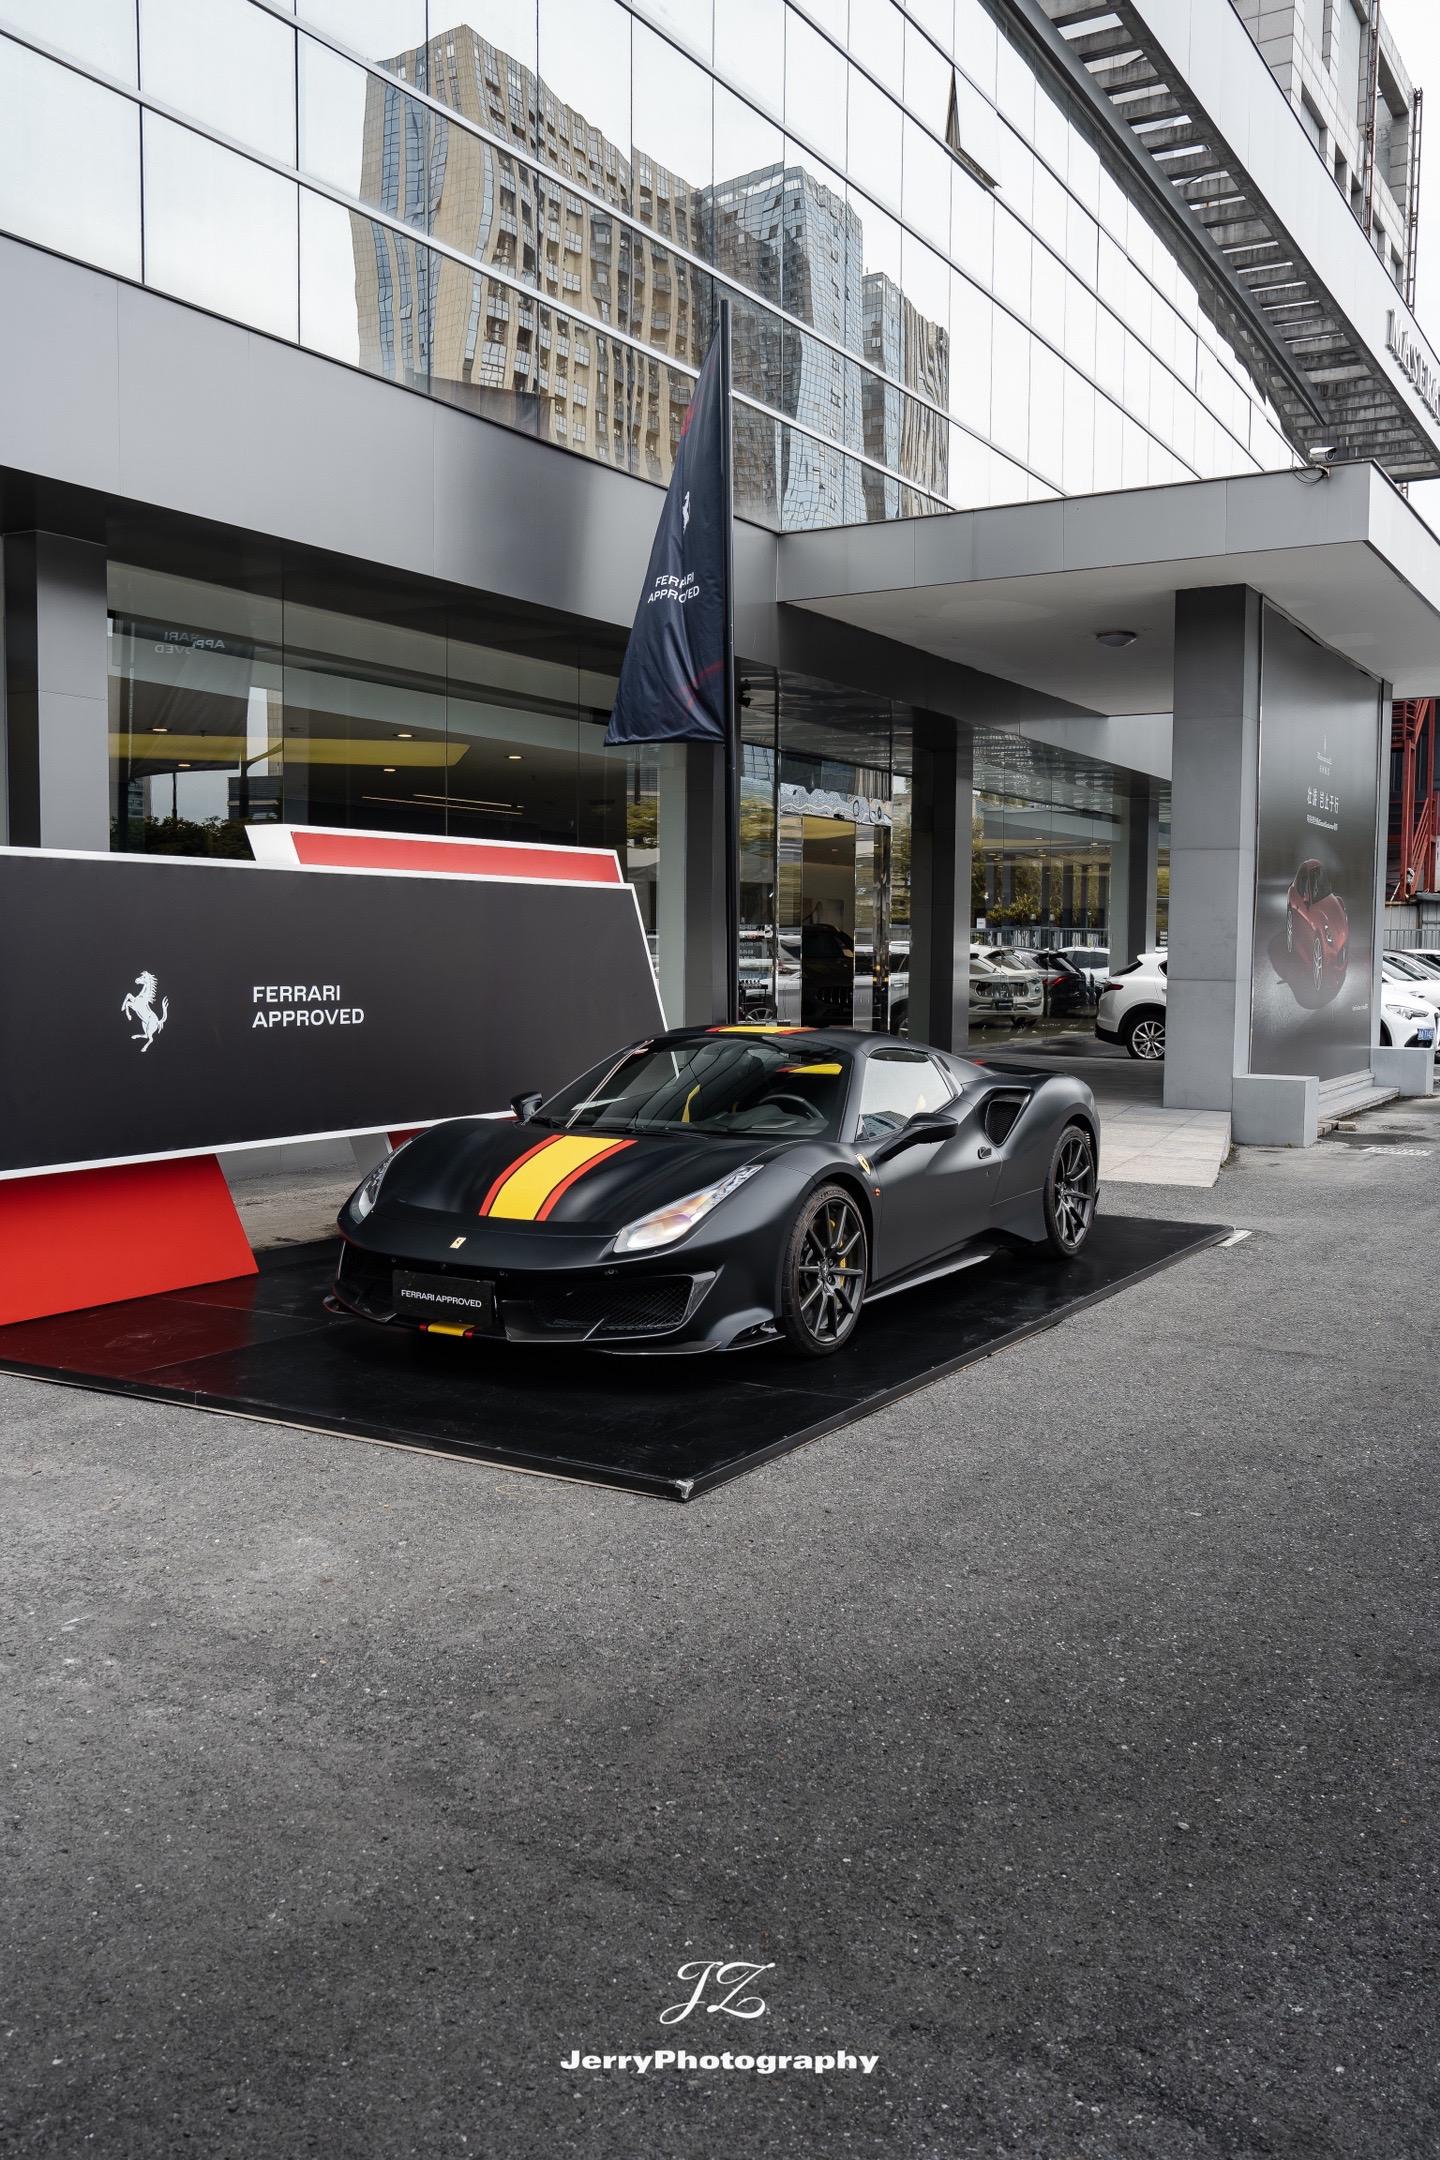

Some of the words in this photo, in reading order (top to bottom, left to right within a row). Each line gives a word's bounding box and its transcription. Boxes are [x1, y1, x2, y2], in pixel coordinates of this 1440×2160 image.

[655, 571, 695, 589] FERARI
[252, 985, 341, 1003] FERRARI
[251, 1008, 365, 1029] APPROVED
[401, 1289, 435, 1301] FERRARI
[435, 1294, 482, 1308] APPROVED
